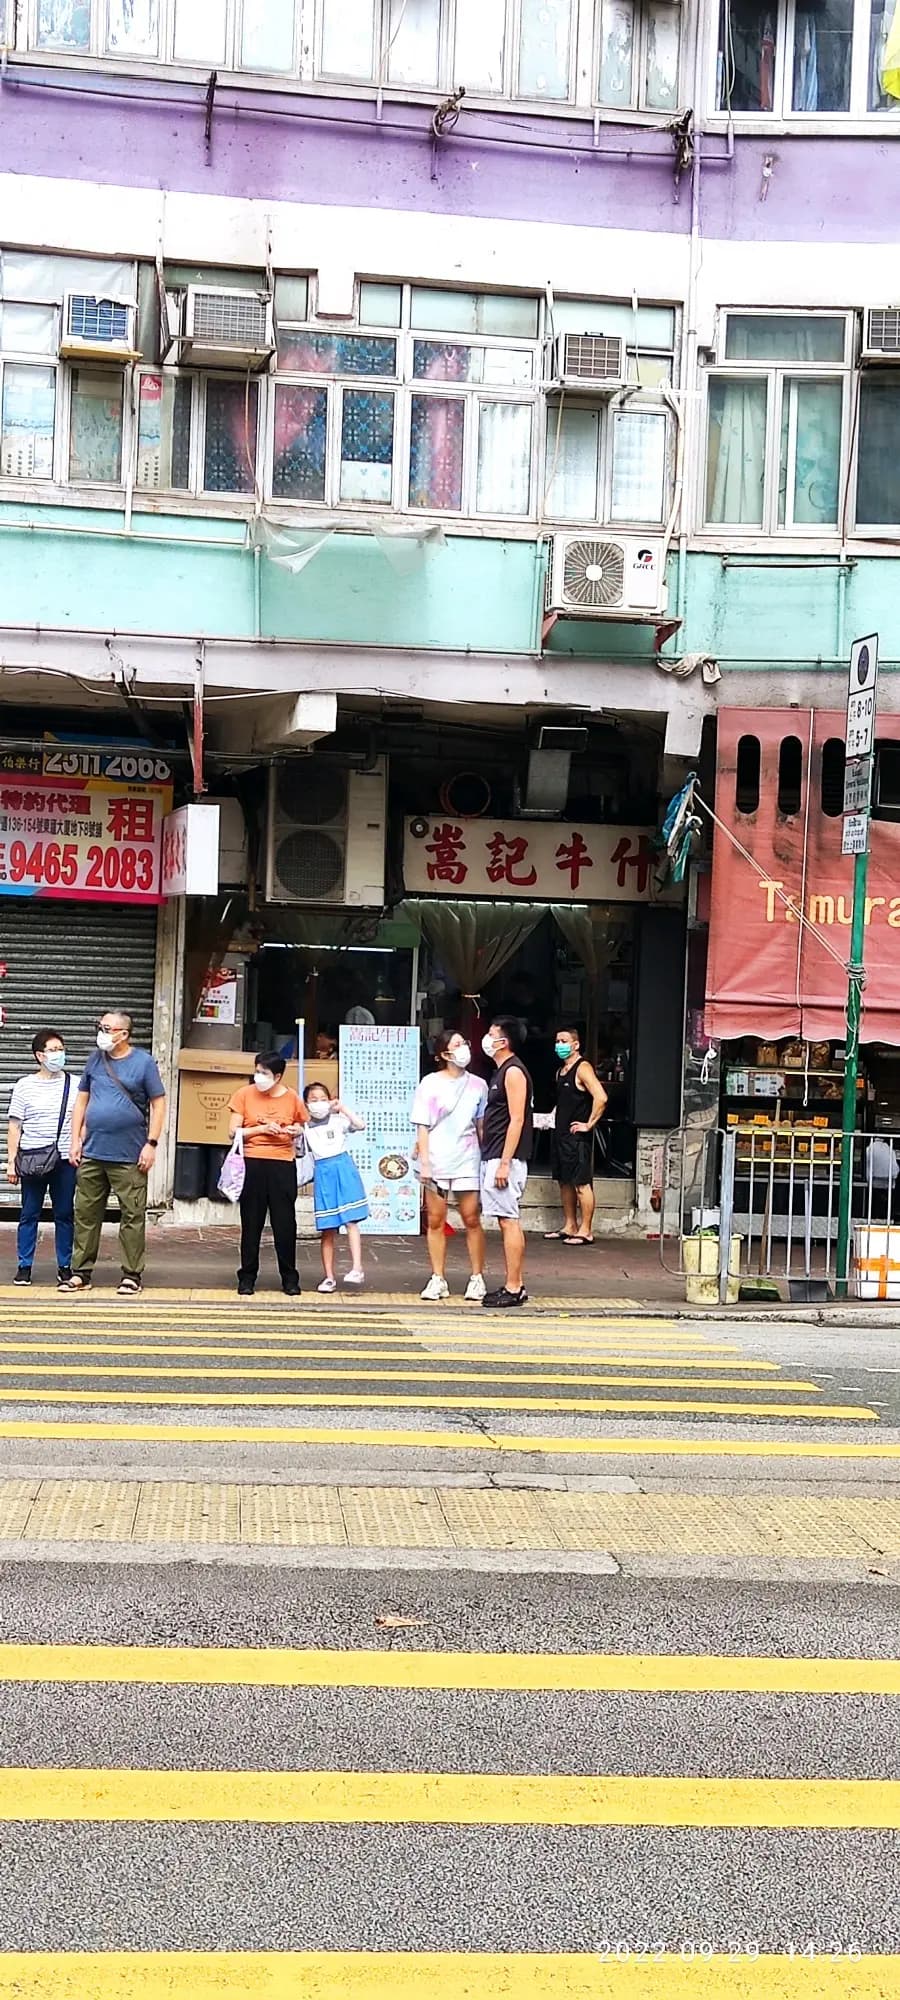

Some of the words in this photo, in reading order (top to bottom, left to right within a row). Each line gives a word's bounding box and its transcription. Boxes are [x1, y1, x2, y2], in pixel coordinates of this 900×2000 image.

[106, 797, 155, 843] 租
[9, 840, 79, 886] 9465
[85, 844, 154, 891] 2083
[425, 822, 658, 894] 嵩記牛什
